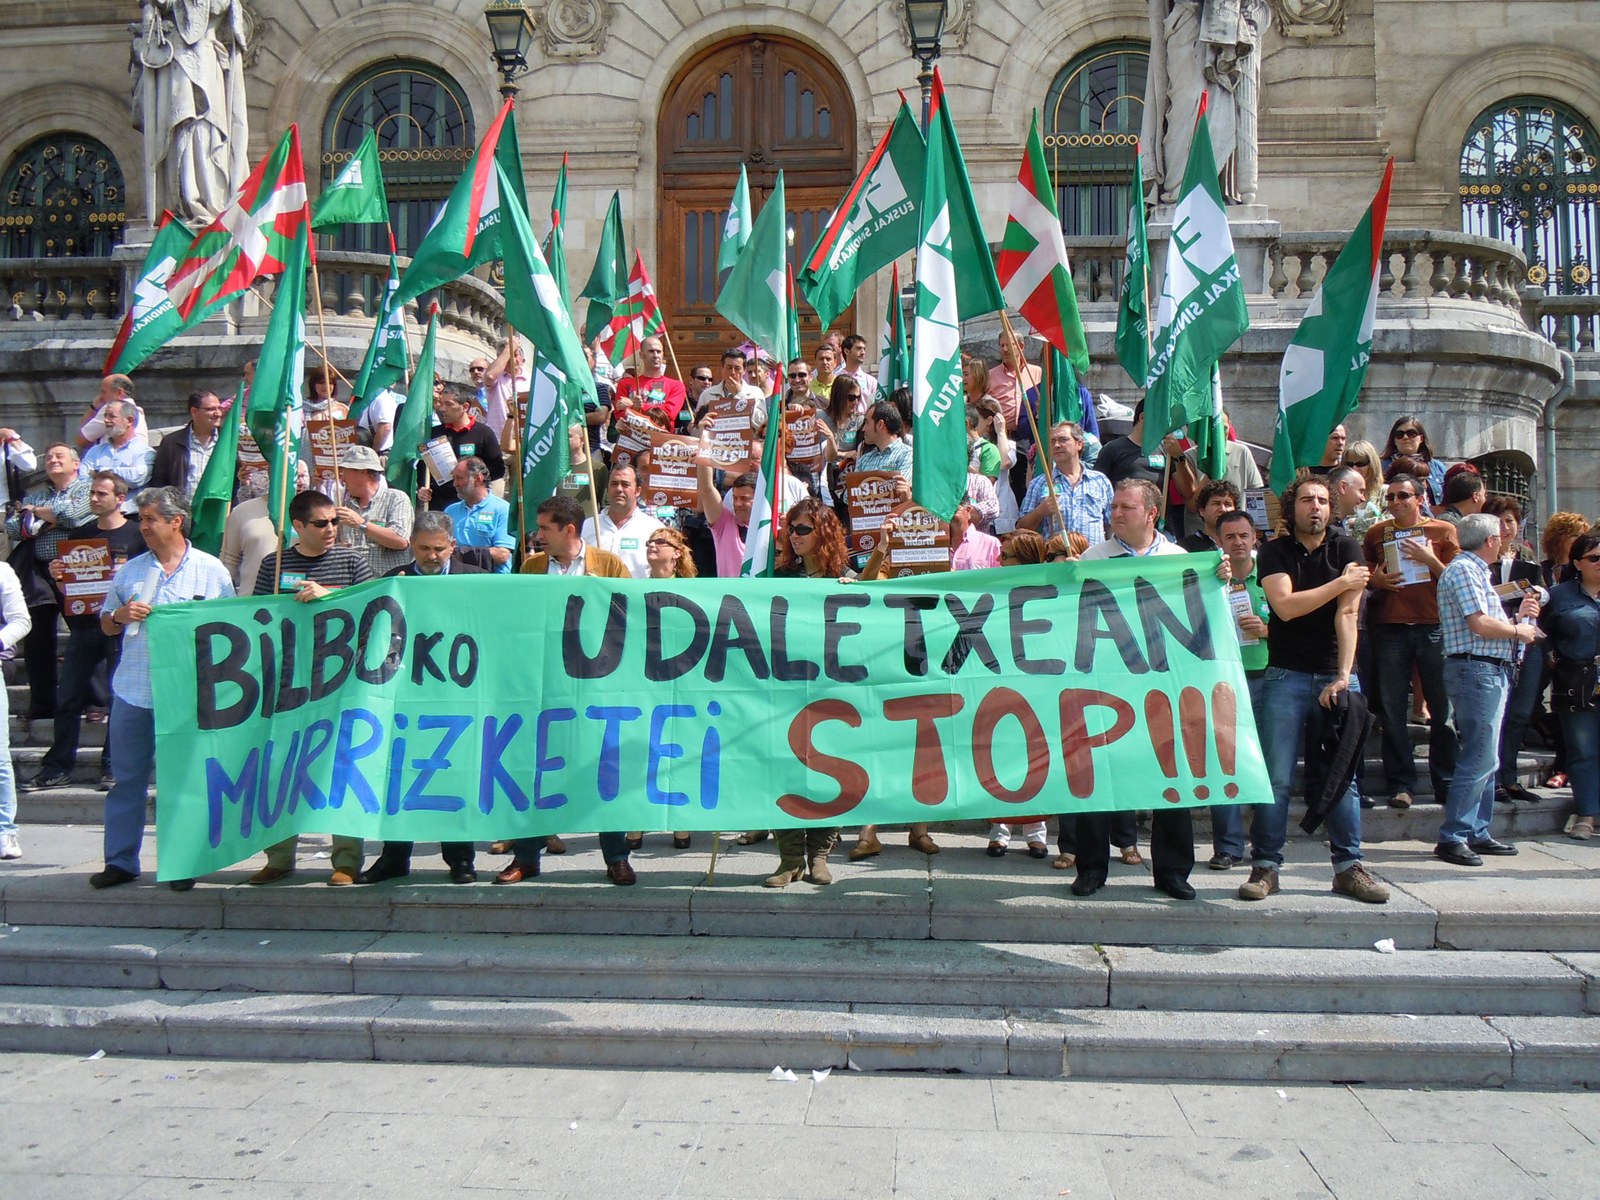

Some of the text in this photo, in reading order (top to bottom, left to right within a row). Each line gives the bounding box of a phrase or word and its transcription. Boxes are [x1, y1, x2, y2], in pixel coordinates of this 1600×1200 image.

[653, 444, 678, 457] m31
[851, 482, 878, 496] m31
[561, 568, 1215, 683] UDALETXEAN
